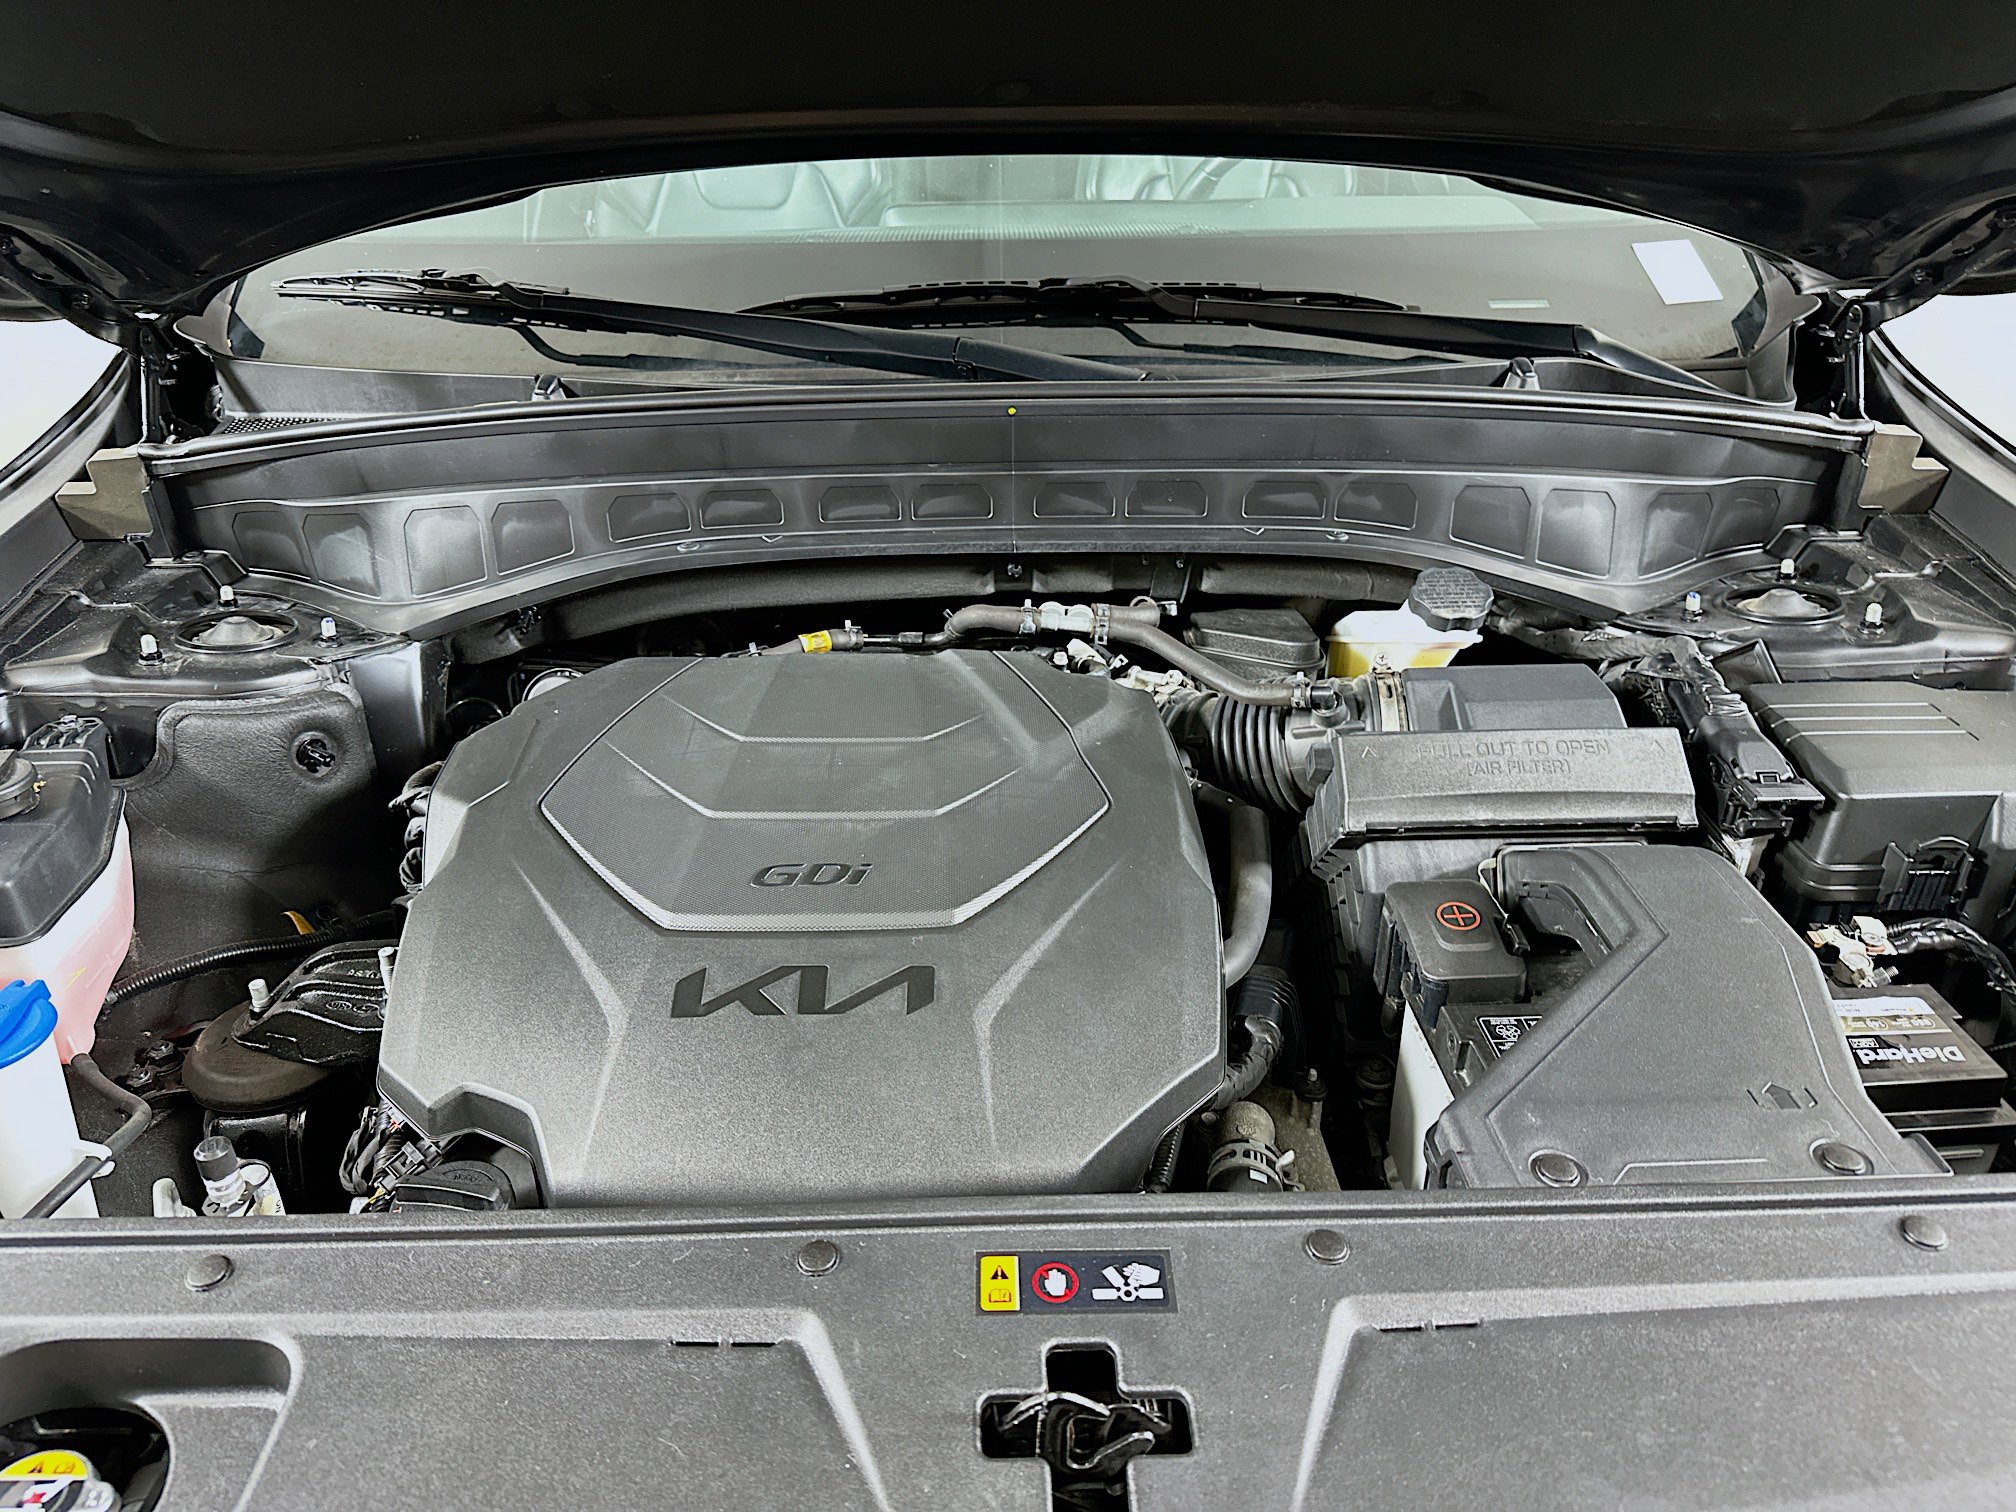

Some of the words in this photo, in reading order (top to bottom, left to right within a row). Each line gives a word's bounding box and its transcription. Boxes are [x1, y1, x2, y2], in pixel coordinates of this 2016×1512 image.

[1418, 742, 1471, 759] PULL
[1476, 741, 1516, 757] OUT
[1521, 740, 1550, 756] TO
[1556, 739, 1611, 755] OPEN
[750, 863, 874, 887] GDi
[670, 965, 936, 1018] KIA
